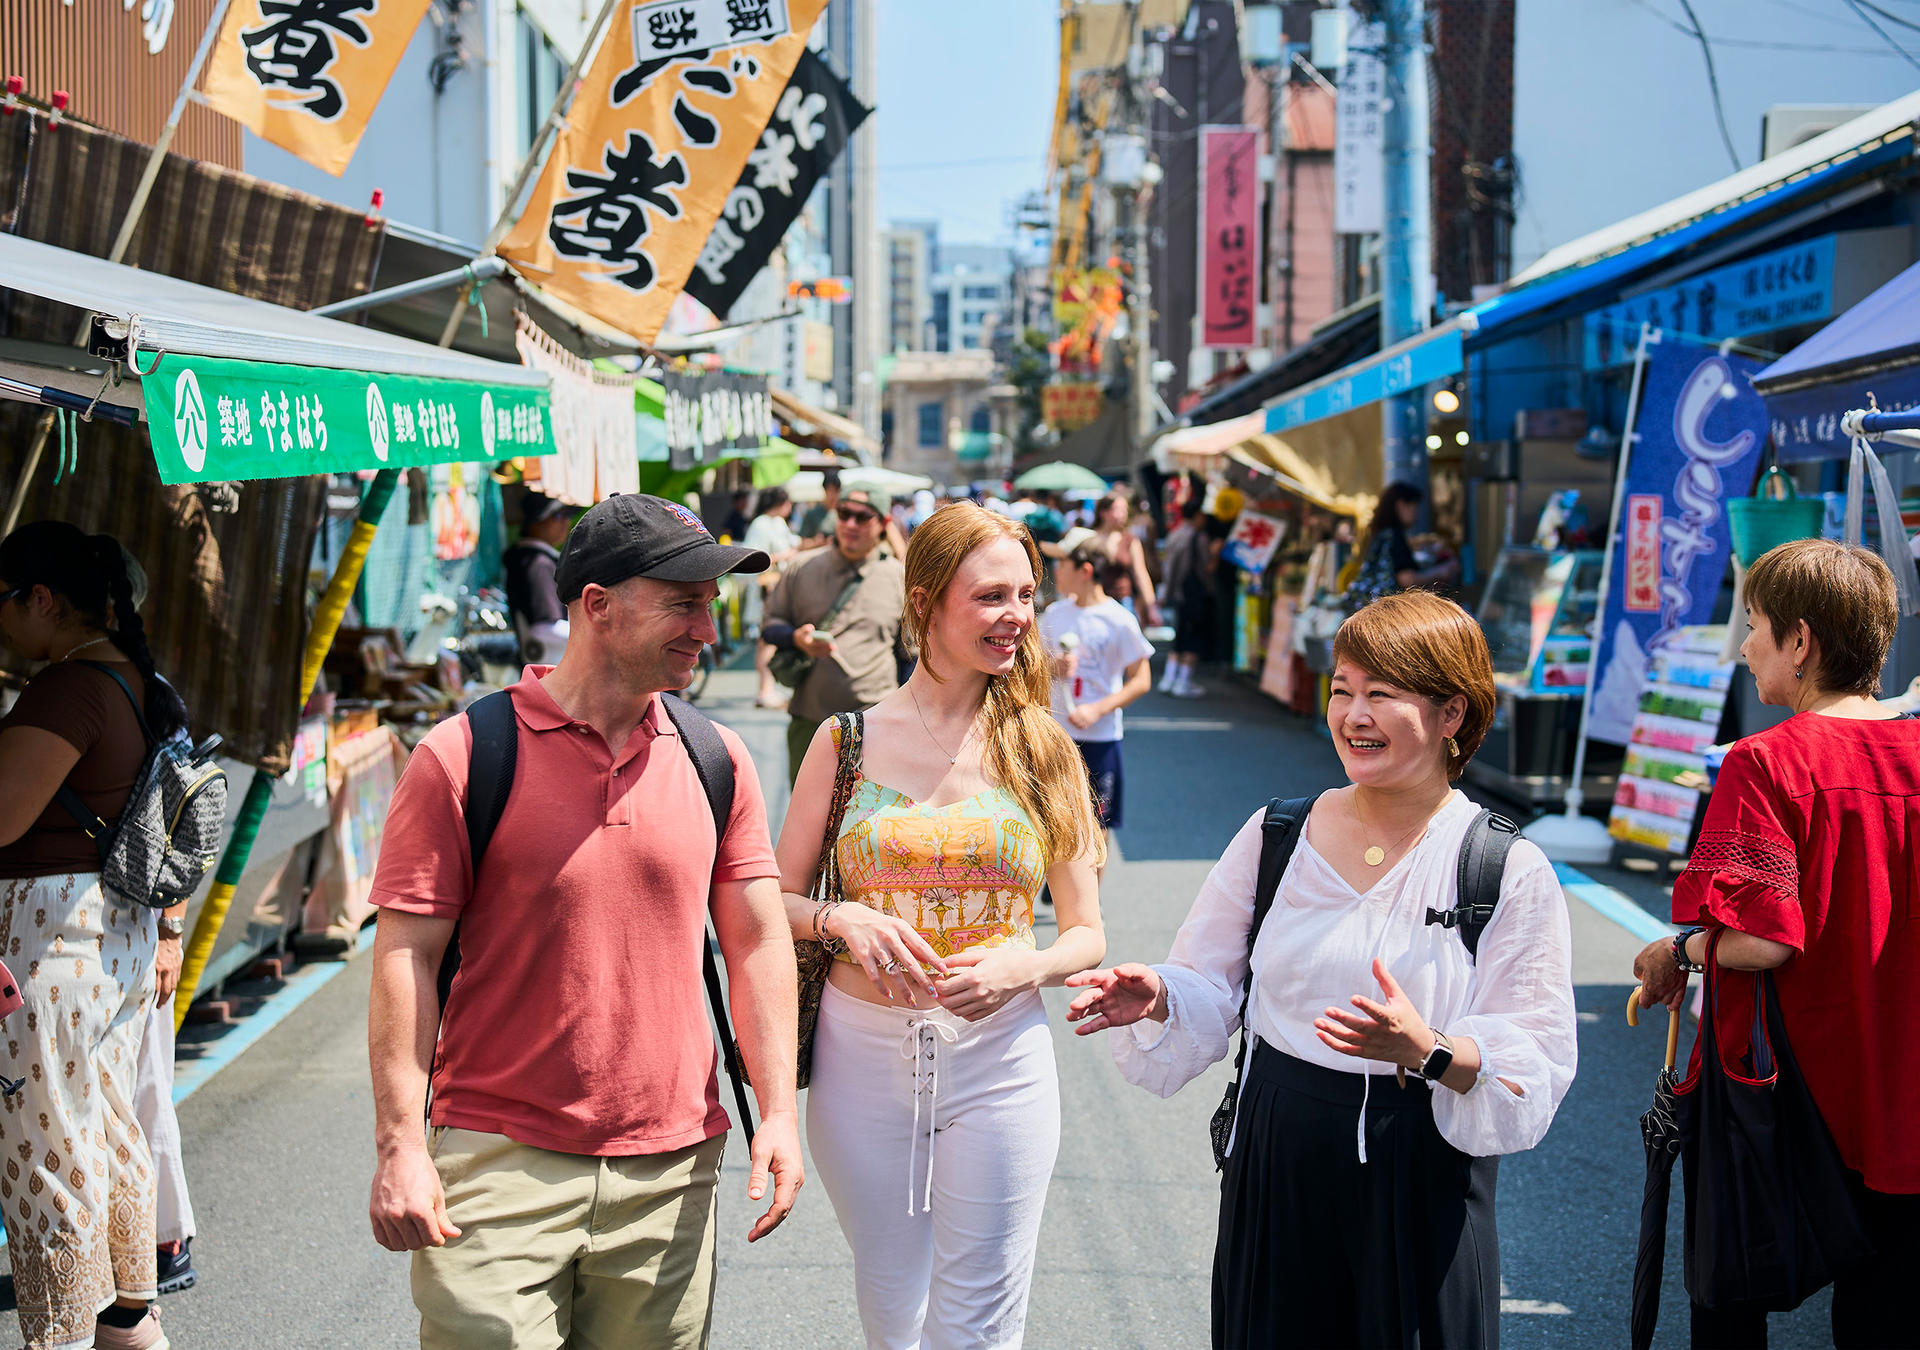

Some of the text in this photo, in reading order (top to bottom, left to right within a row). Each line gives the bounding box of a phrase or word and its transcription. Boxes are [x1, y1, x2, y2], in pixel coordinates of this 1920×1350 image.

[217, 390, 328, 453] 築地 やまはち
[391, 398, 460, 449] 築地 やまはち
[497, 406, 513, 442] 築地
[512, 402, 545, 445] やまはち
